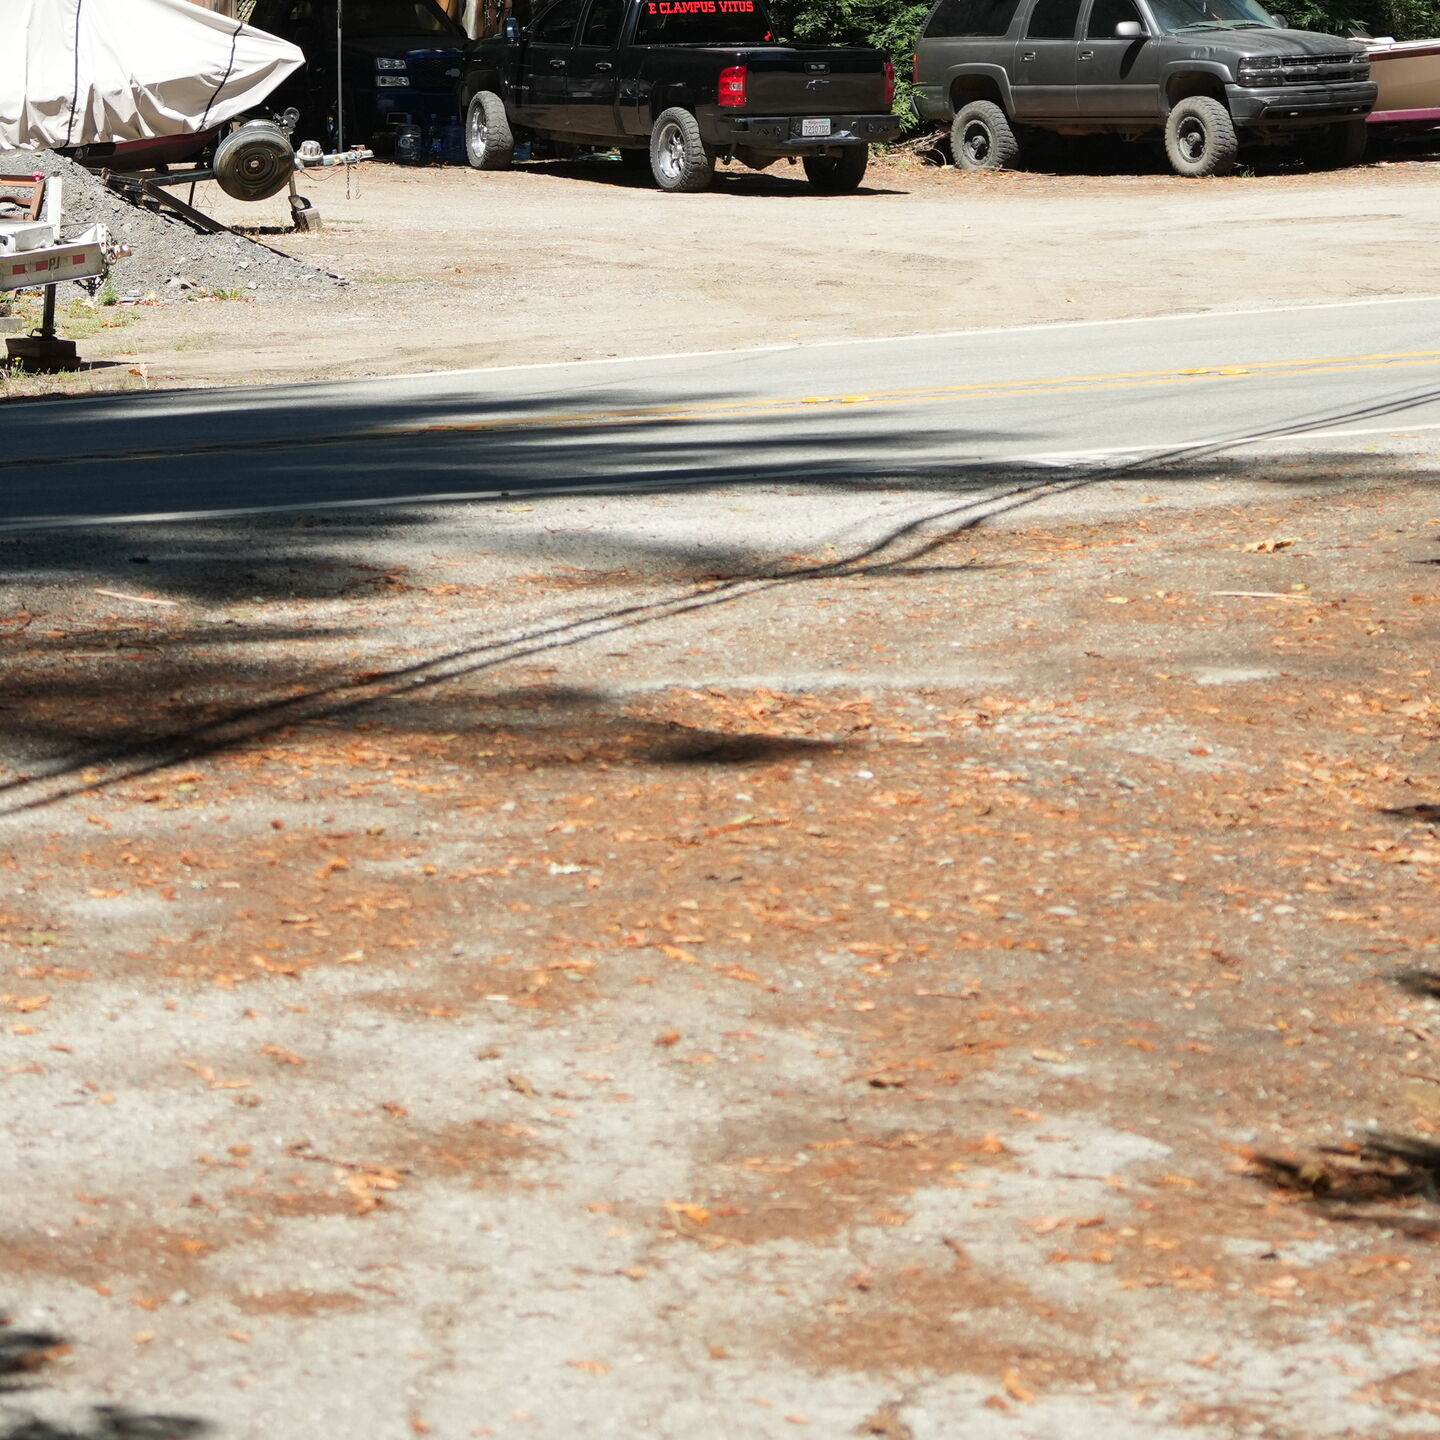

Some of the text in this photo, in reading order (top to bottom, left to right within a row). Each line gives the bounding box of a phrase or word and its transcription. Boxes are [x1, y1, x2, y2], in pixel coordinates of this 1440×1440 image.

[648, 0, 754, 14] E CLAMPUS VITUS
[48, 255, 61, 271] PJ
